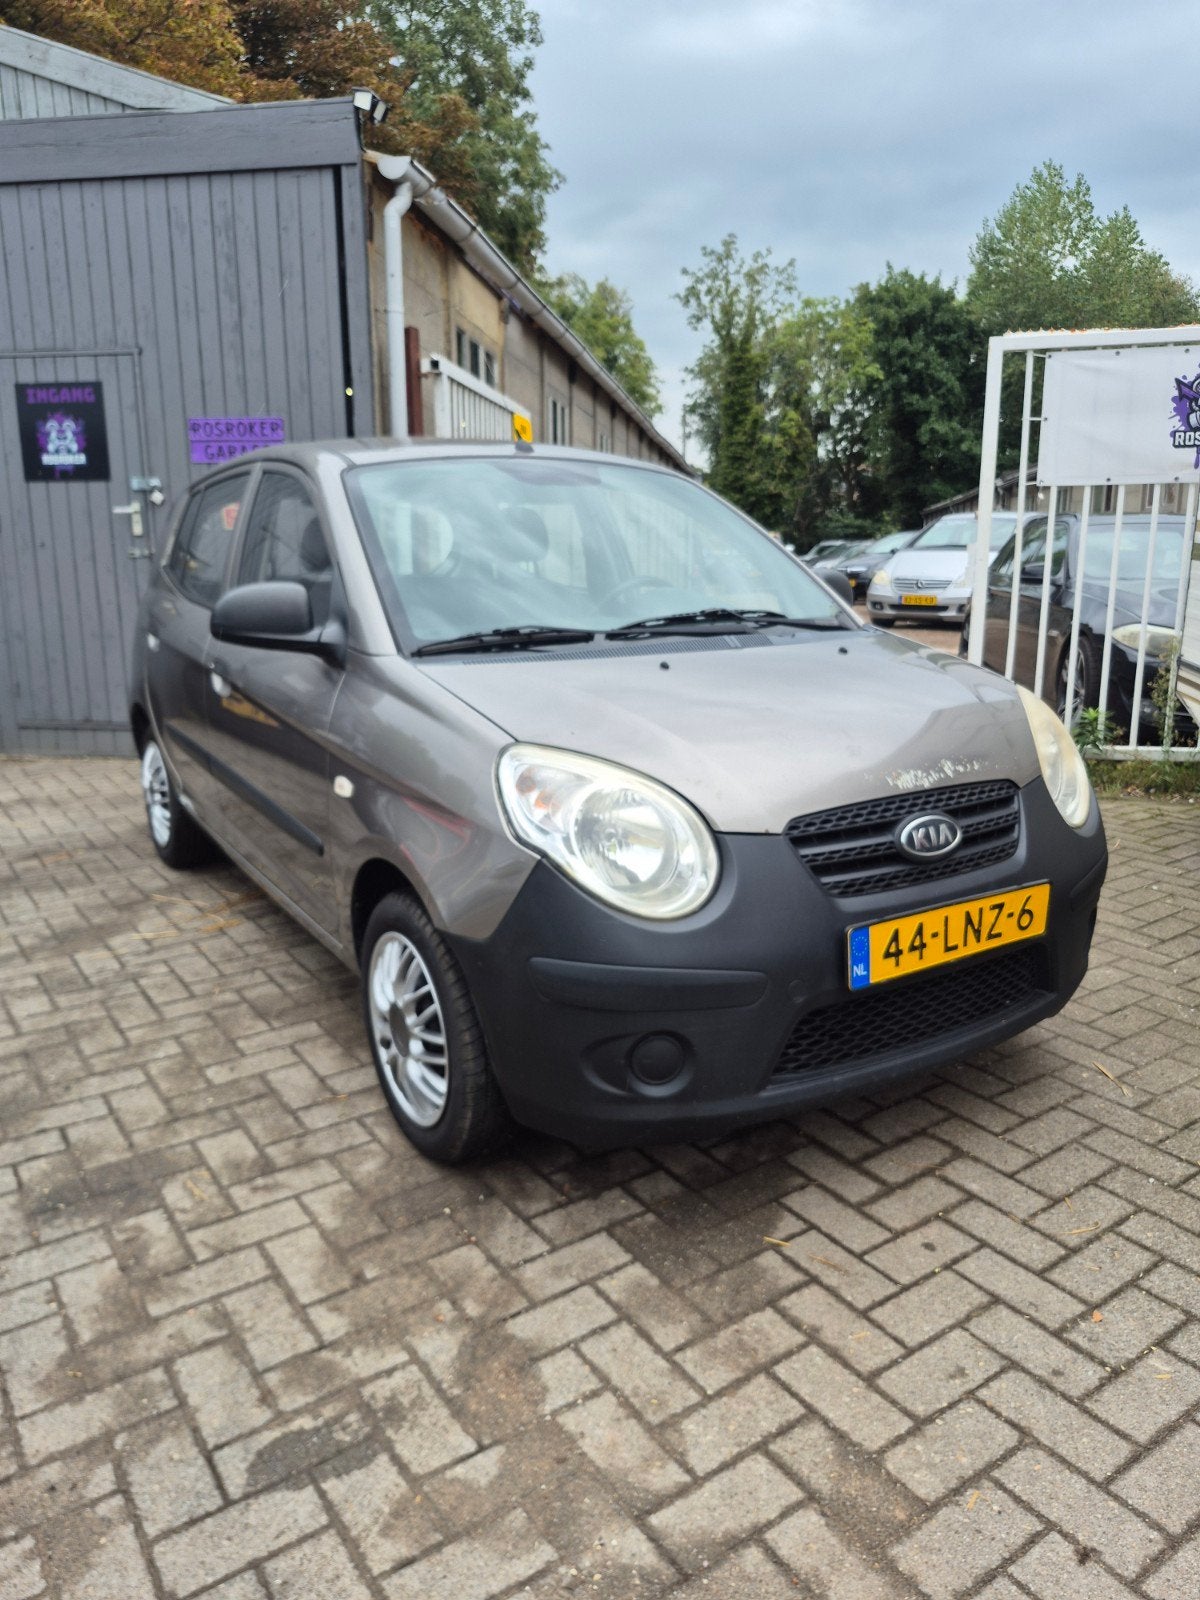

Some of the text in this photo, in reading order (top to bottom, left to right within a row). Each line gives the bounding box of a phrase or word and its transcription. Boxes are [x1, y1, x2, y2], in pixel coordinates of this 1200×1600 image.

[26, 387, 96, 404] INGANG
[204, 445, 270, 460] GARA
[911, 823, 954, 850] KIA
[882, 895, 1034, 967] 44-LNZ-6
[853, 963, 867, 978] NL
